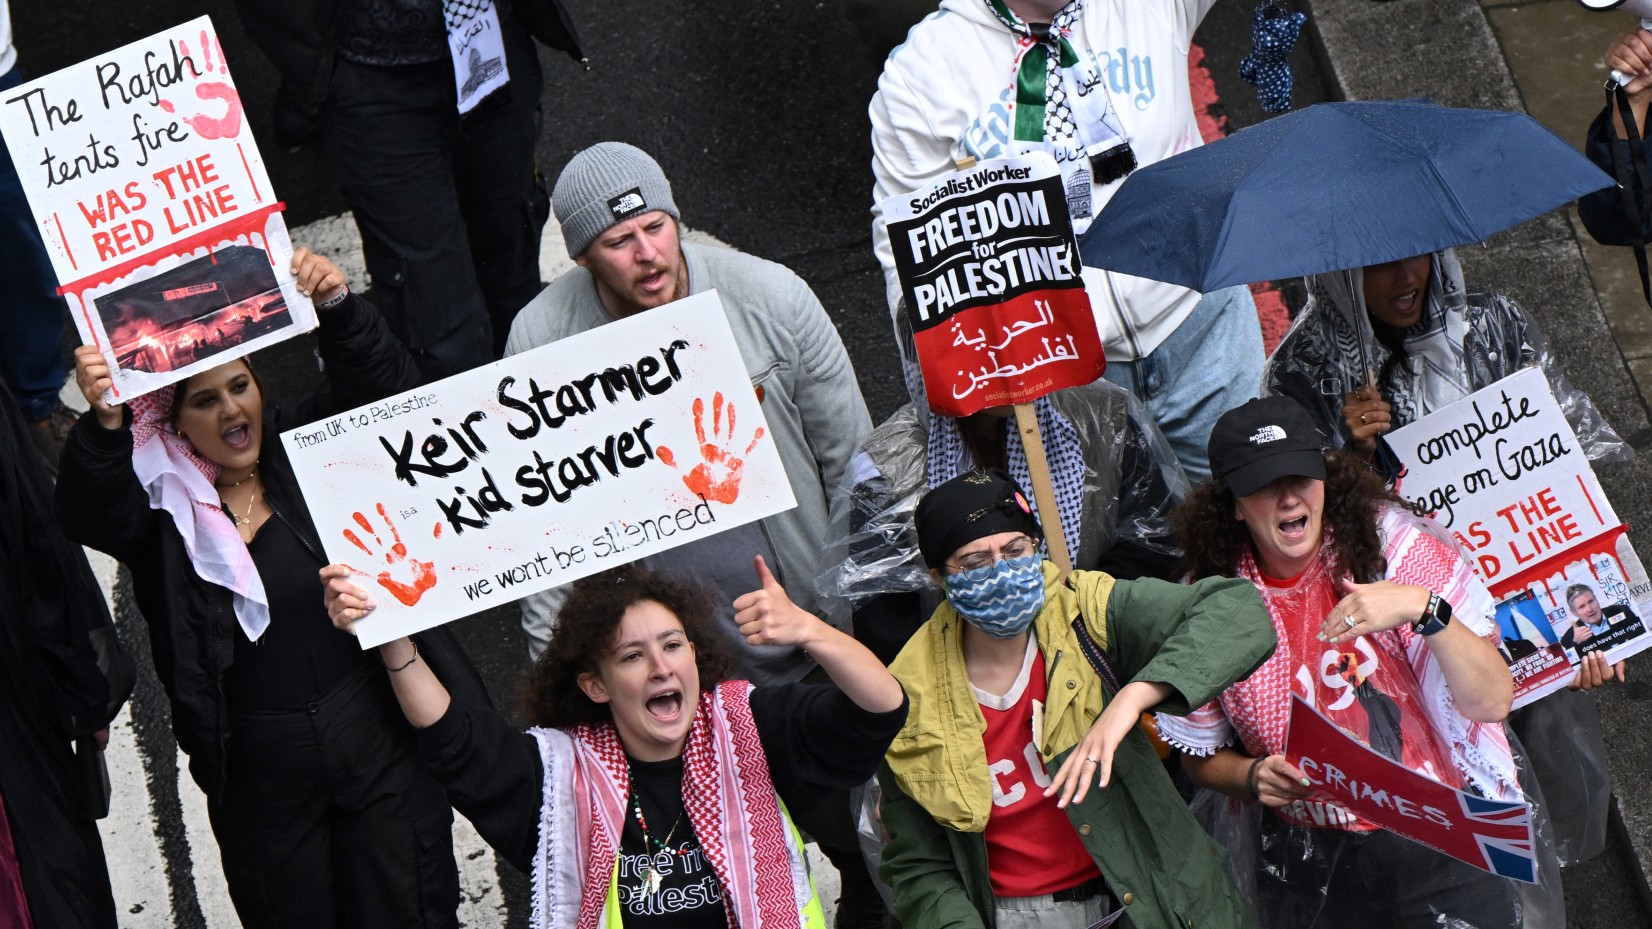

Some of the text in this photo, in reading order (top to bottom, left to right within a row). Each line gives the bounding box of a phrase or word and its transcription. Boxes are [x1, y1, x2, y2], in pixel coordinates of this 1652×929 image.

[7, 39, 202, 136] The Rafah
[40, 115, 189, 189] tents fire
[76, 153, 220, 229] WAS THE
[92, 184, 238, 262] RED LINE
[907, 190, 1050, 264] FREEDOM
[972, 241, 998, 259] for
[952, 333, 1080, 400] لفلسطين
[984, 377, 1054, 402] socialistworker.co.uk
[293, 392, 438, 450] from UK to Palestine
[378, 339, 689, 488] Keir Starmer
[1249, 431, 1275, 442] NORTH
[1257, 425, 1273, 433] THE
[1257, 436, 1276, 445] FACE
[1417, 389, 1540, 465] complete
[434, 417, 658, 536] kid starver
[1463, 468, 1499, 494] on
[1495, 432, 1571, 481] Gaza
[1496, 486, 1563, 534] THE
[1508, 513, 1582, 565] LINE
[463, 577, 493, 602] we
[555, 543, 587, 569] be
[592, 493, 716, 558] silenced
[1598, 572, 1618, 589] SIR
[1603, 582, 1626, 600] KID
[1582, 621, 1642, 653] does have that right
[1299, 756, 1455, 830] CRIMES
